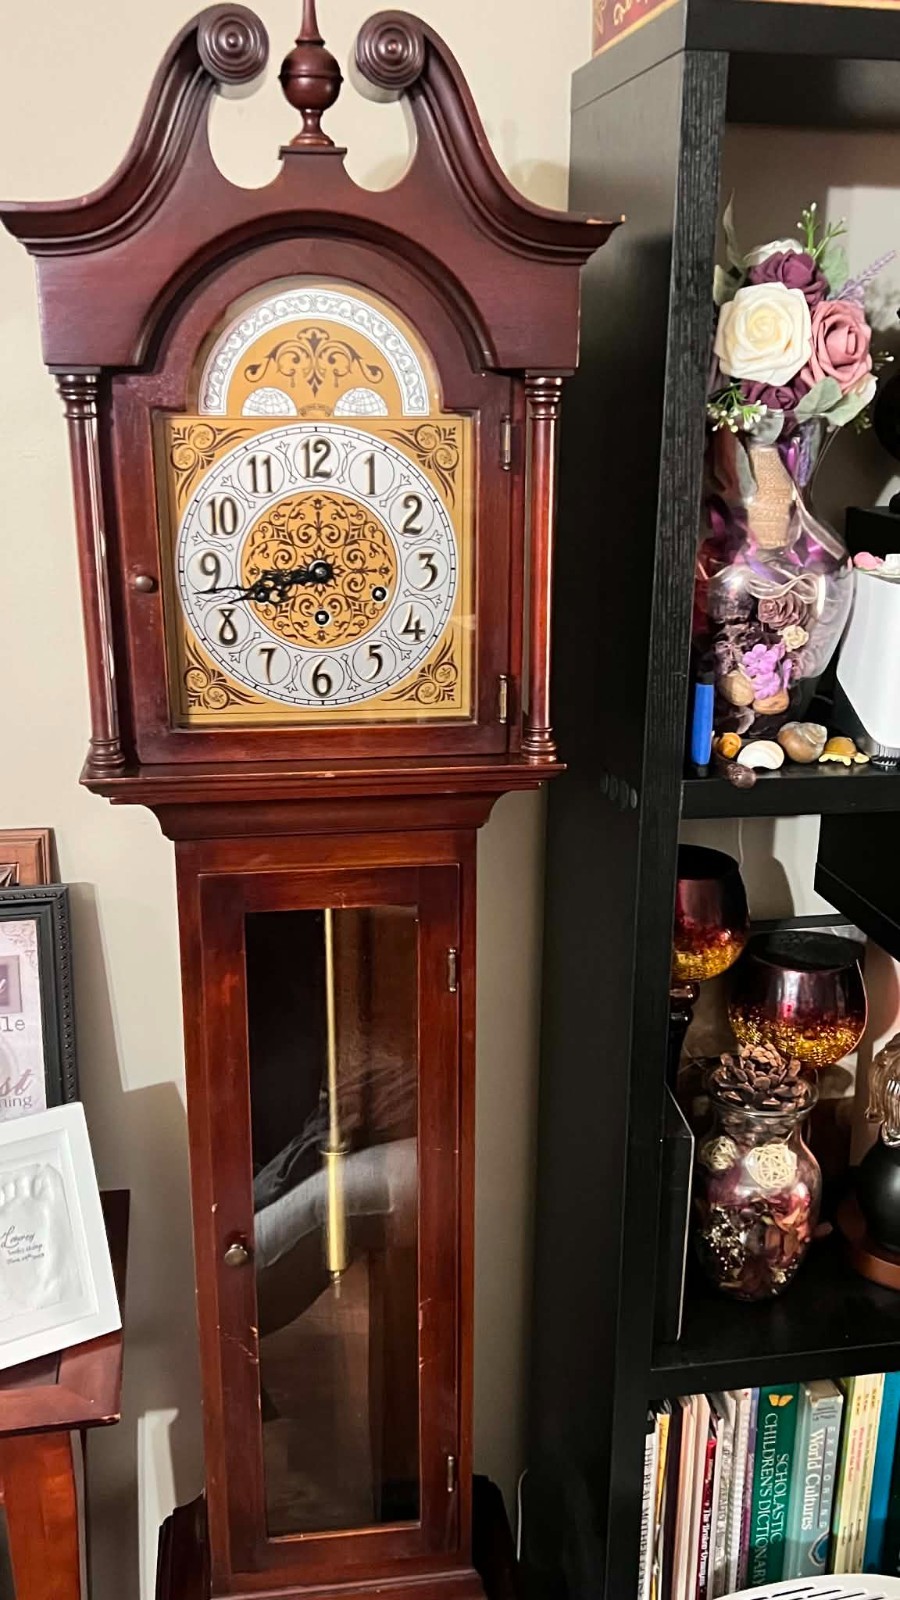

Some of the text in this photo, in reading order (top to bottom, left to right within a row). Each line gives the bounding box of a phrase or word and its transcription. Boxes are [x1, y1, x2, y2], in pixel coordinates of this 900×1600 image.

[247, 453, 273, 495] 11
[301, 437, 332, 480] 12
[363, 452, 376, 495] 1
[206, 496, 238, 536] 10
[403, 495, 423, 535] 2
[199, 552, 221, 590] 9
[417, 552, 439, 591] 3
[217, 608, 238, 645] 8
[399, 603, 426, 642] 4
[259, 647, 278, 684] 7
[312, 657, 333, 698] 6
[365, 644, 384, 682] 5
[806, 1428, 825, 1471] World
[818, 1426, 836, 1529] EXPLORING
[752, 1412, 779, 1586] CHILDREN'S DICTIONARY
[769, 1453, 789, 1545] SCHOLASTIC
[801, 1473, 820, 1531] Cultures
